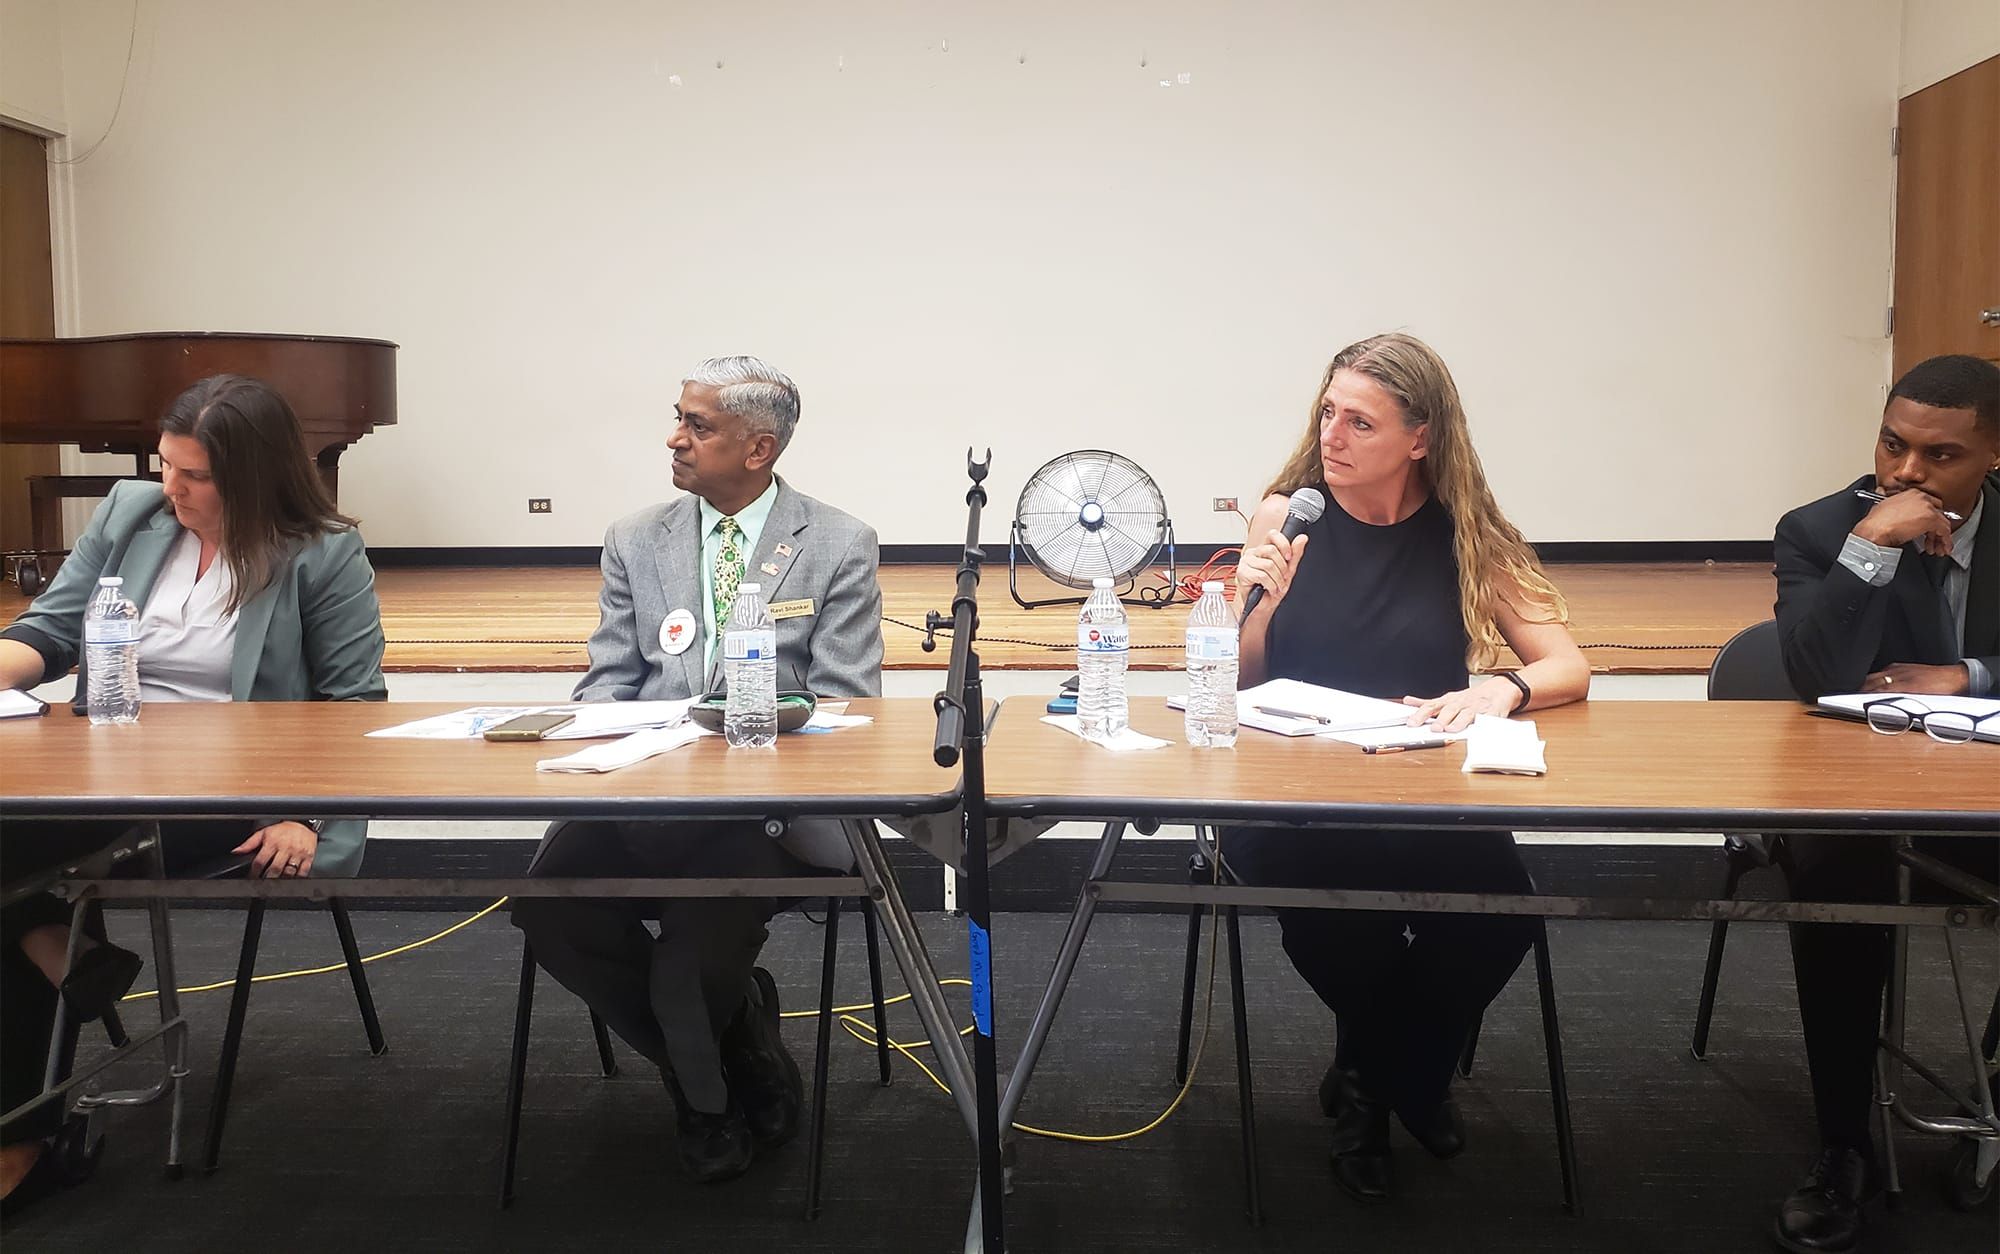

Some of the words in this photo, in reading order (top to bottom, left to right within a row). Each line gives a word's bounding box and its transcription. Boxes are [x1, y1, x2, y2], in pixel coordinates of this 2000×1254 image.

[770, 607, 784, 615] Ravi
[785, 604, 809, 612] Shankar
[1103, 634, 1128, 643] Water
